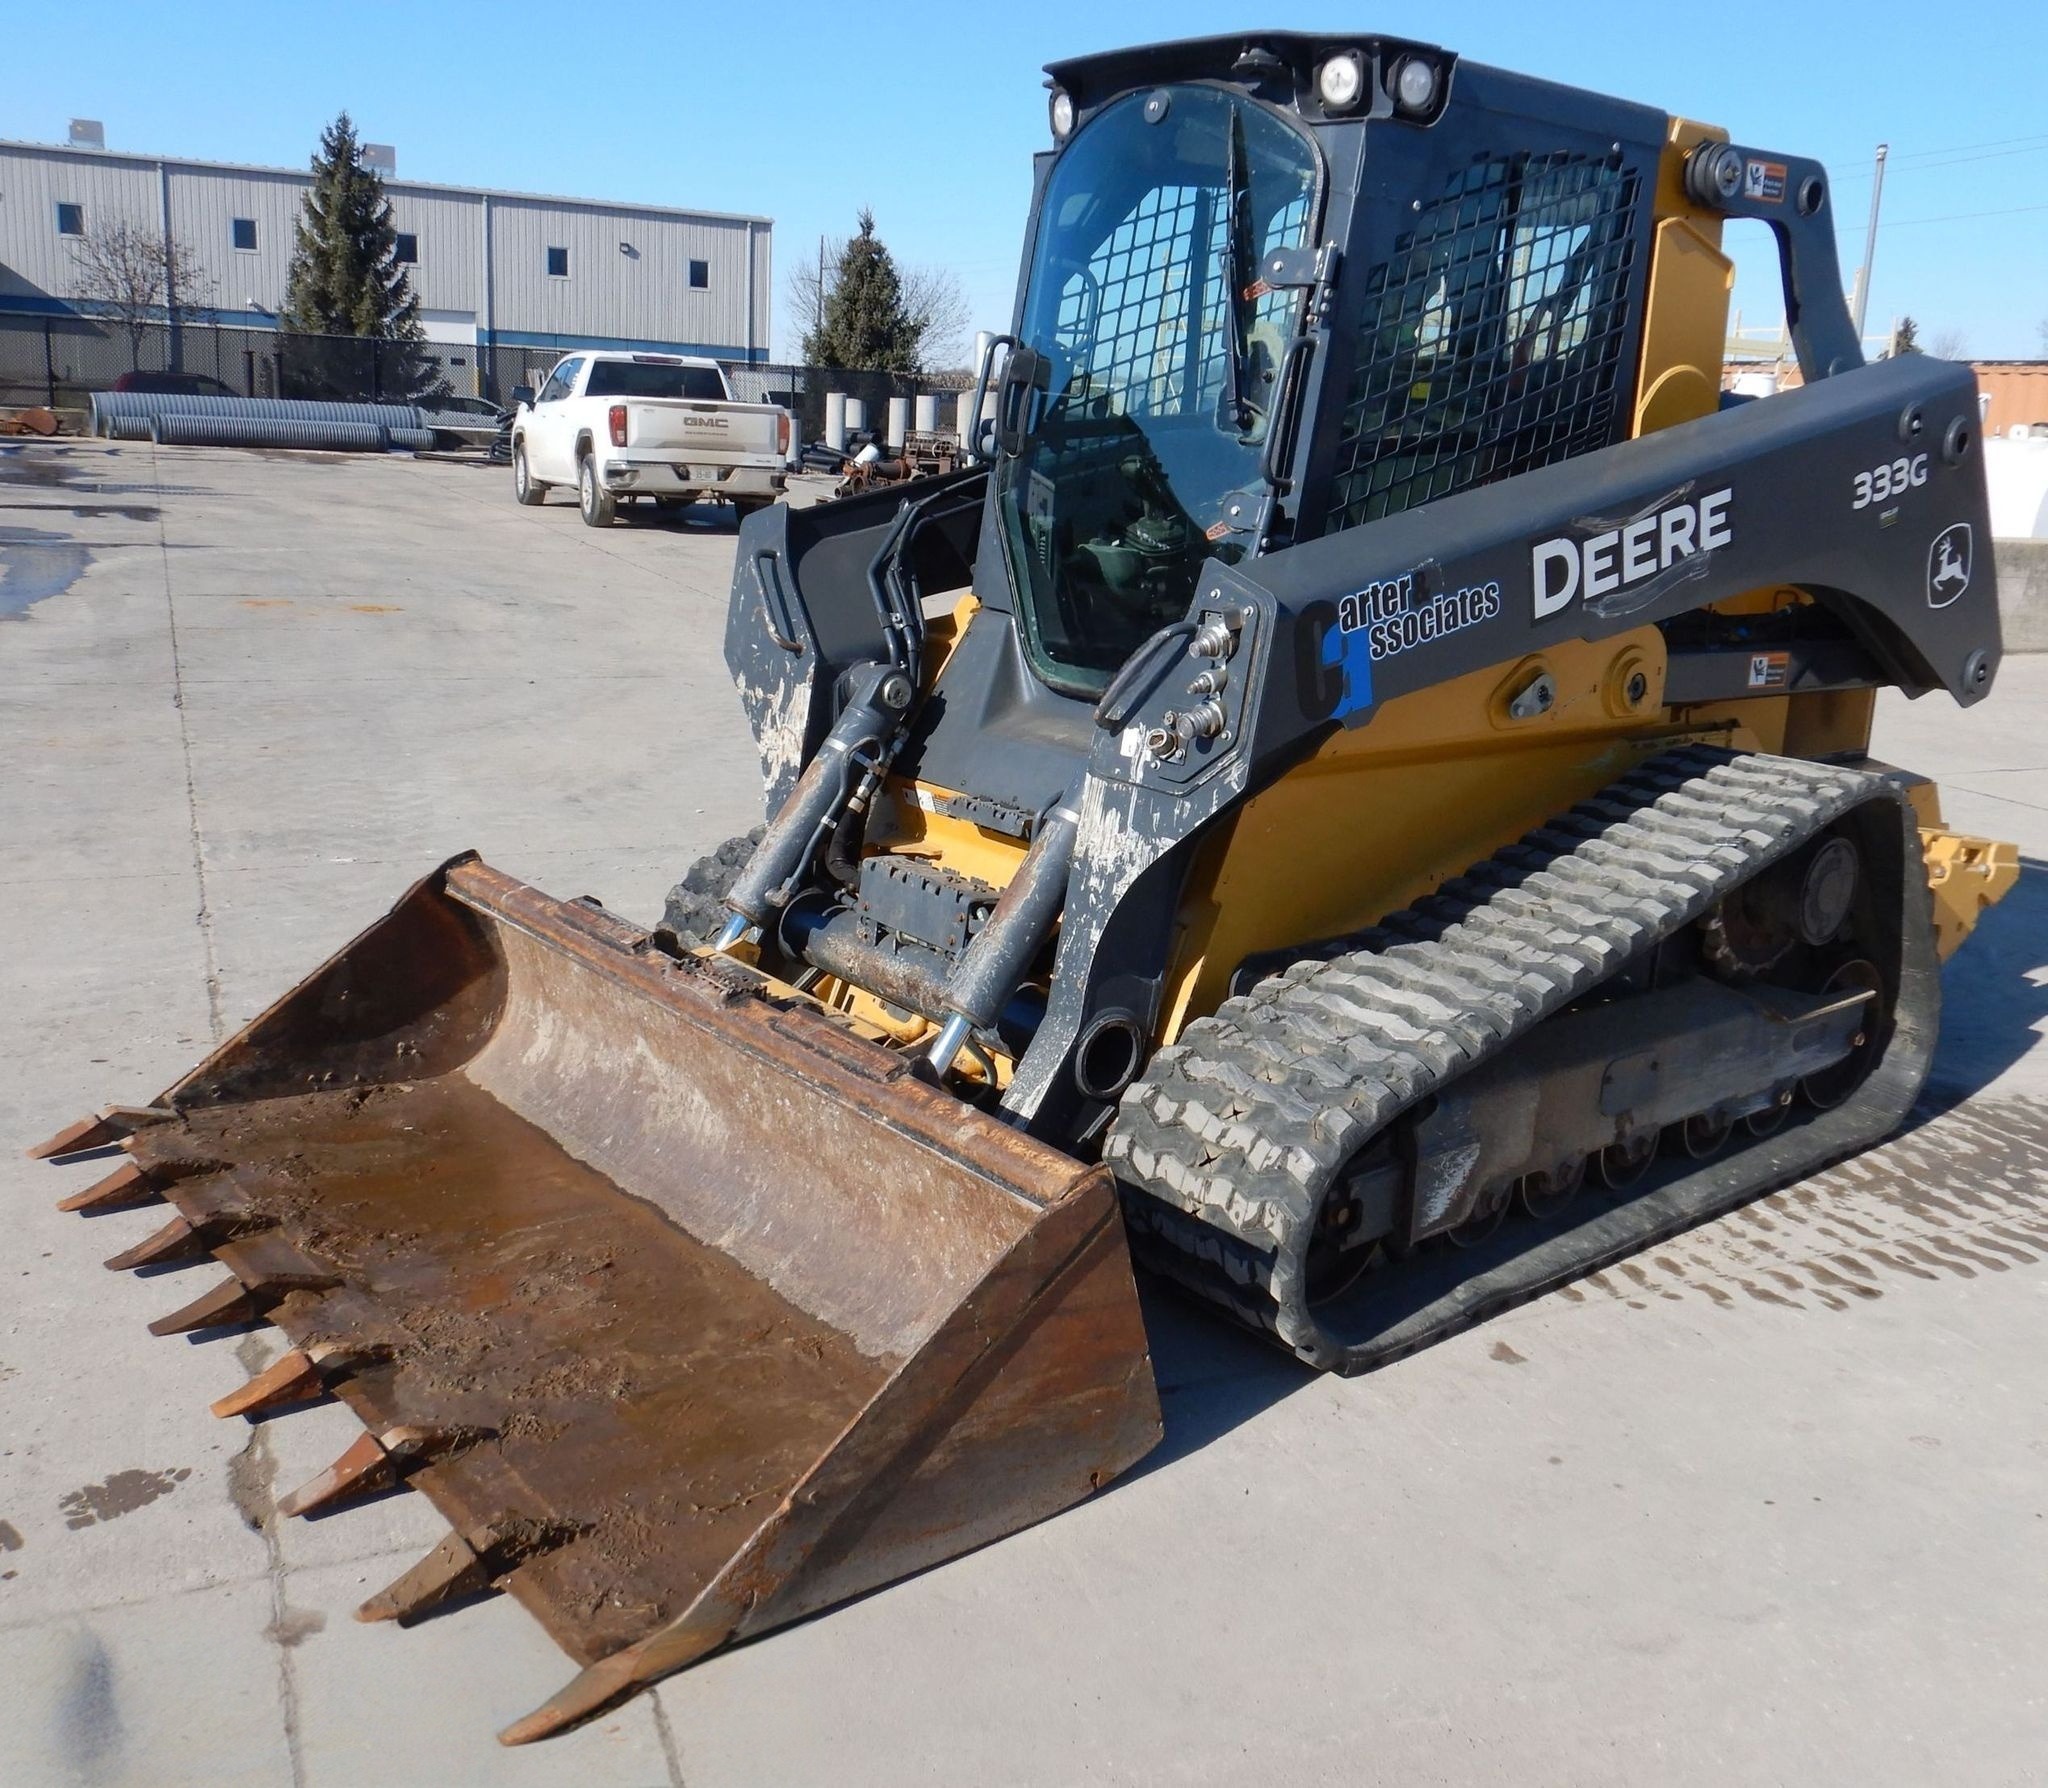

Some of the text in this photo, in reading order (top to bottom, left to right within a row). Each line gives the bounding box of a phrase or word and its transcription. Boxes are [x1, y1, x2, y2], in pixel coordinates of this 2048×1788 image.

[683, 416, 729, 428] GMC
[1852, 453, 1928, 510] 333G
[1533, 488, 1733, 620] DEERE
